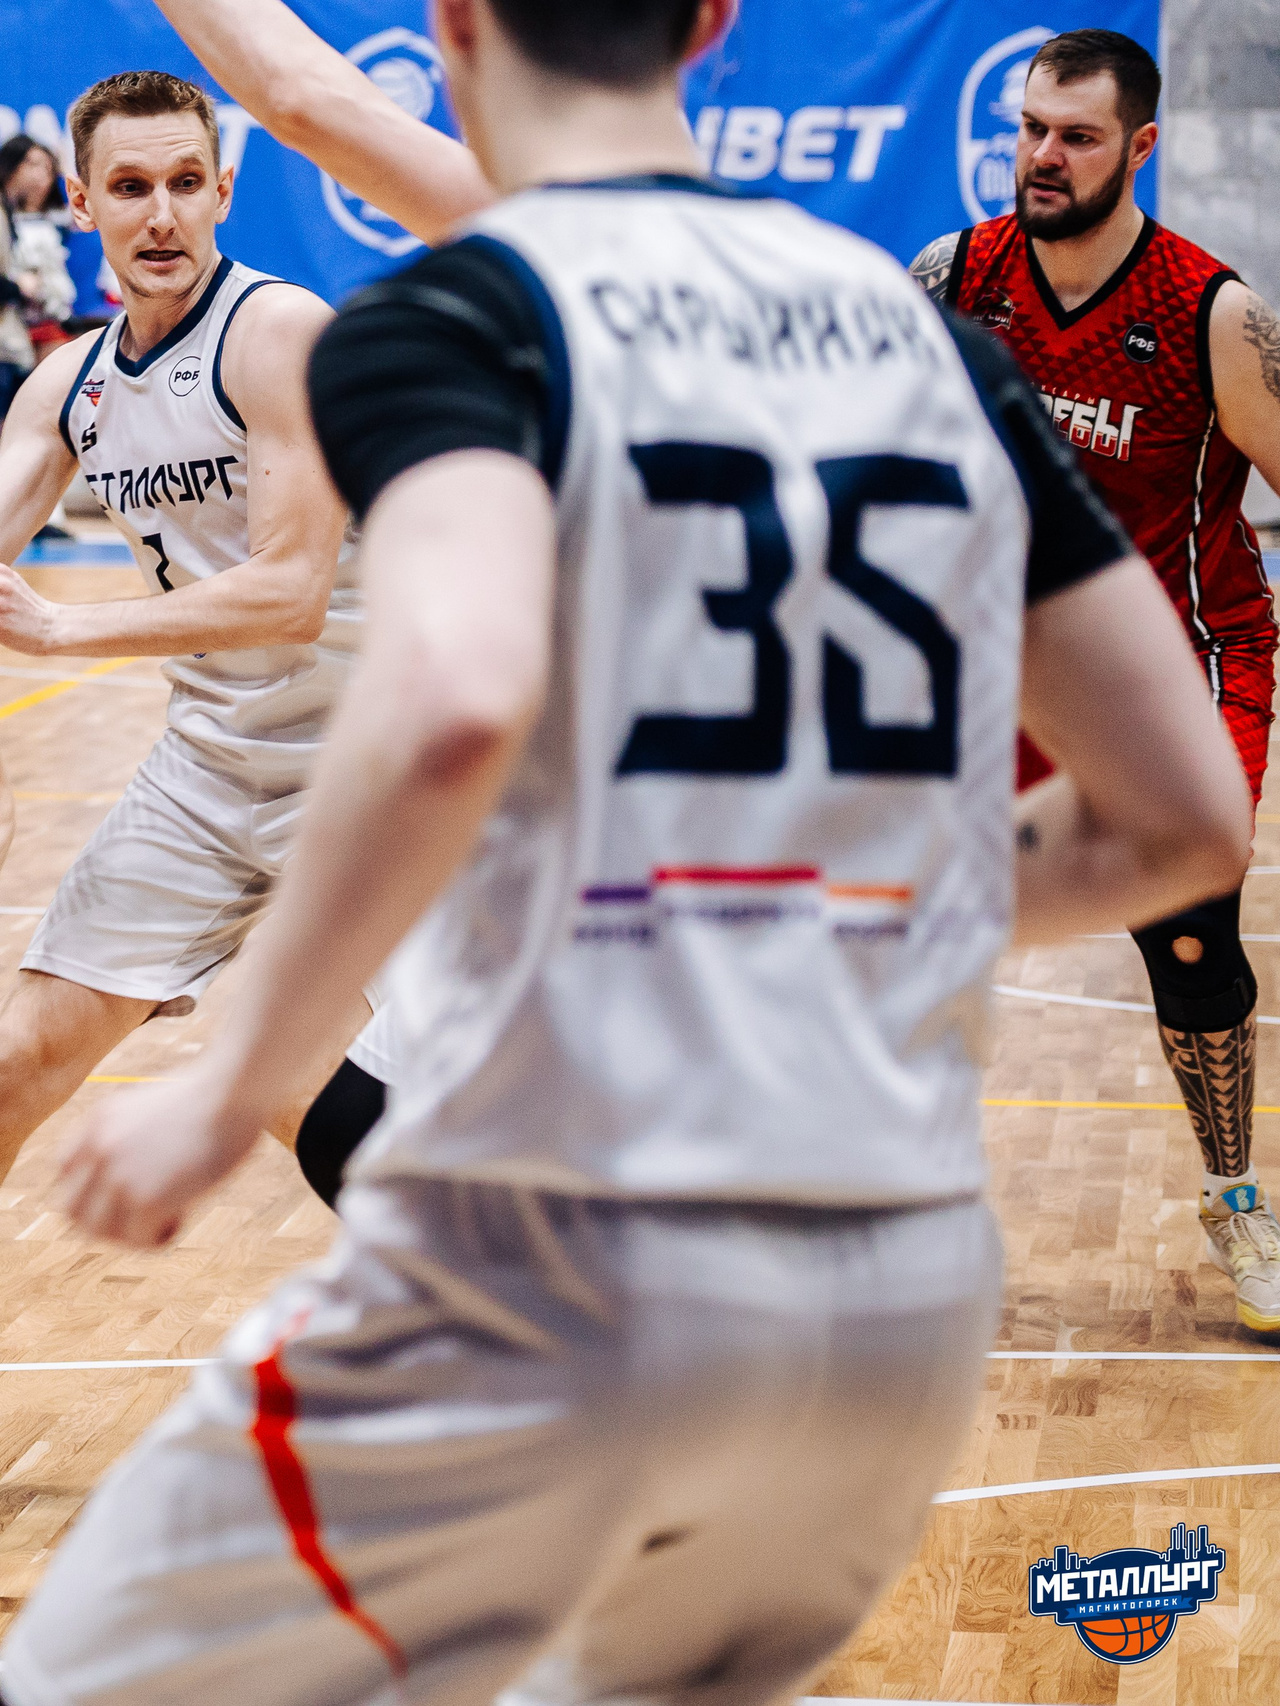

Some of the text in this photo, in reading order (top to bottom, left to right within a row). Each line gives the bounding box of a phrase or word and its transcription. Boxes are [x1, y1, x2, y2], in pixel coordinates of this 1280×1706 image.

[1128, 335, 1156, 352] РФБ
[173, 370, 201, 383] РФБ
[85, 455, 239, 515] ЕТАЛЛУРГ
